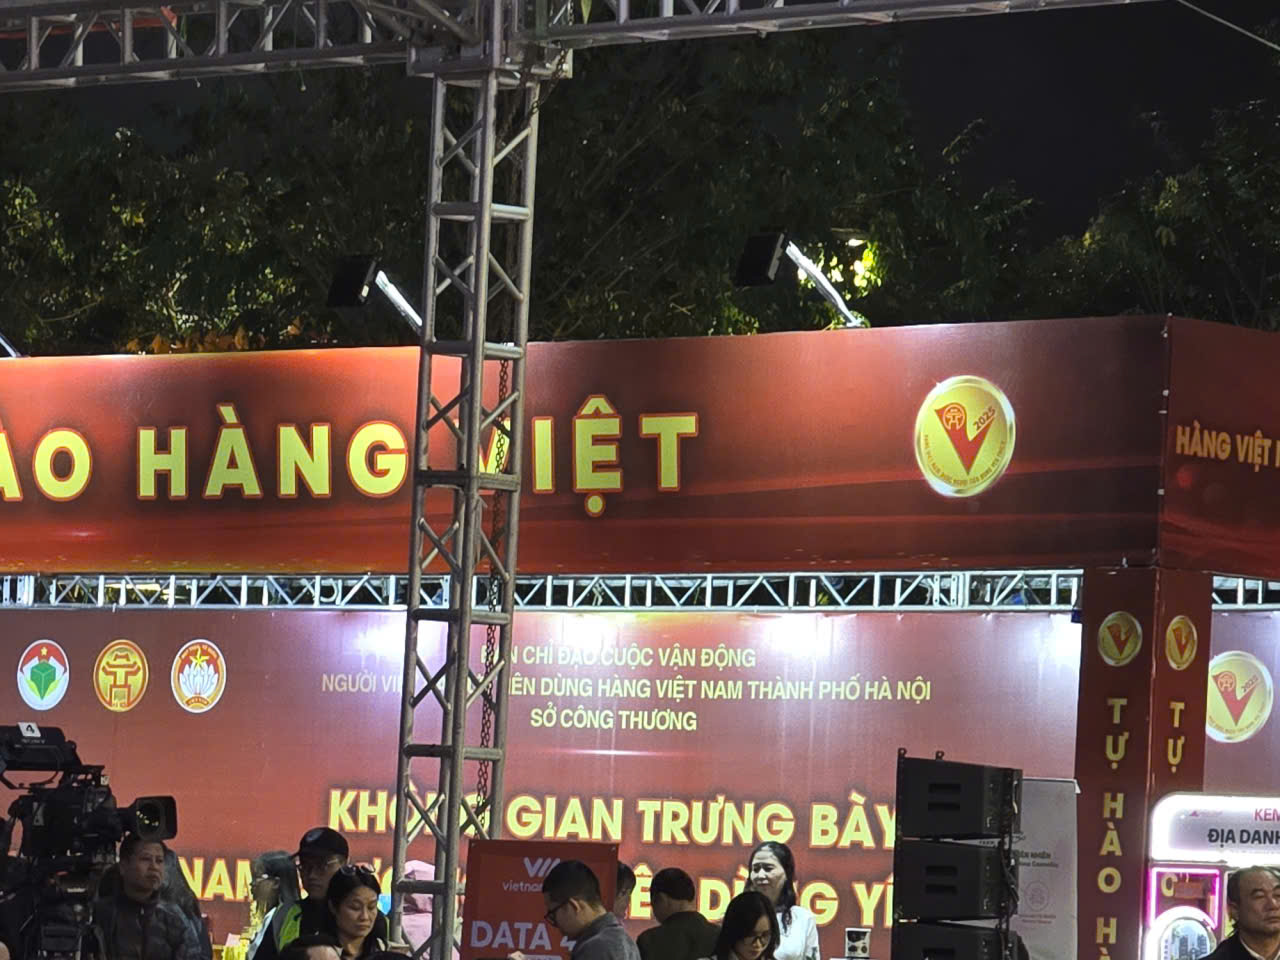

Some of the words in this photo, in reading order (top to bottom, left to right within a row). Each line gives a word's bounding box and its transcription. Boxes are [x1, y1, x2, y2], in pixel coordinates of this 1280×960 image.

[972, 405, 996, 431] 2025
[136, 403, 410, 499] HÀNG
[1176, 419, 1231, 460] HÀNG
[1235, 429, 1272, 473] VIỆT
[481, 645, 518, 665] BN
[522, 639, 553, 665] CHỈ
[557, 645, 595, 670] ĐẠO
[600, 643, 653, 670] CUỘC
[658, 643, 696, 671] VẬN
[700, 643, 756, 671] ĐỘNG
[322, 672, 377, 693] NGƯỜI
[540, 677, 594, 698] DÙNG
[598, 675, 651, 699] HÀNG
[655, 675, 696, 702] VIỆT
[701, 680, 742, 700] NAM
[747, 676, 813, 700] THÀNH
[819, 674, 860, 701] PHỐ
[865, 676, 892, 701] HÀ
[897, 676, 932, 704] NỘI
[531, 702, 557, 728] SỞ
[560, 705, 614, 730] CÔNG
[618, 708, 697, 731] THƯƠNG
[1105, 698, 1129, 769] TỰ
[1167, 701, 1185, 773] TỰ
[506, 794, 623, 840] GIAN
[637, 793, 795, 846] TRƯNG
[809, 789, 896, 850] BÀY
[1207, 828, 1236, 848] ĐỊA
[1097, 791, 1125, 894] HÀO
[471, 920, 552, 951] DATA
